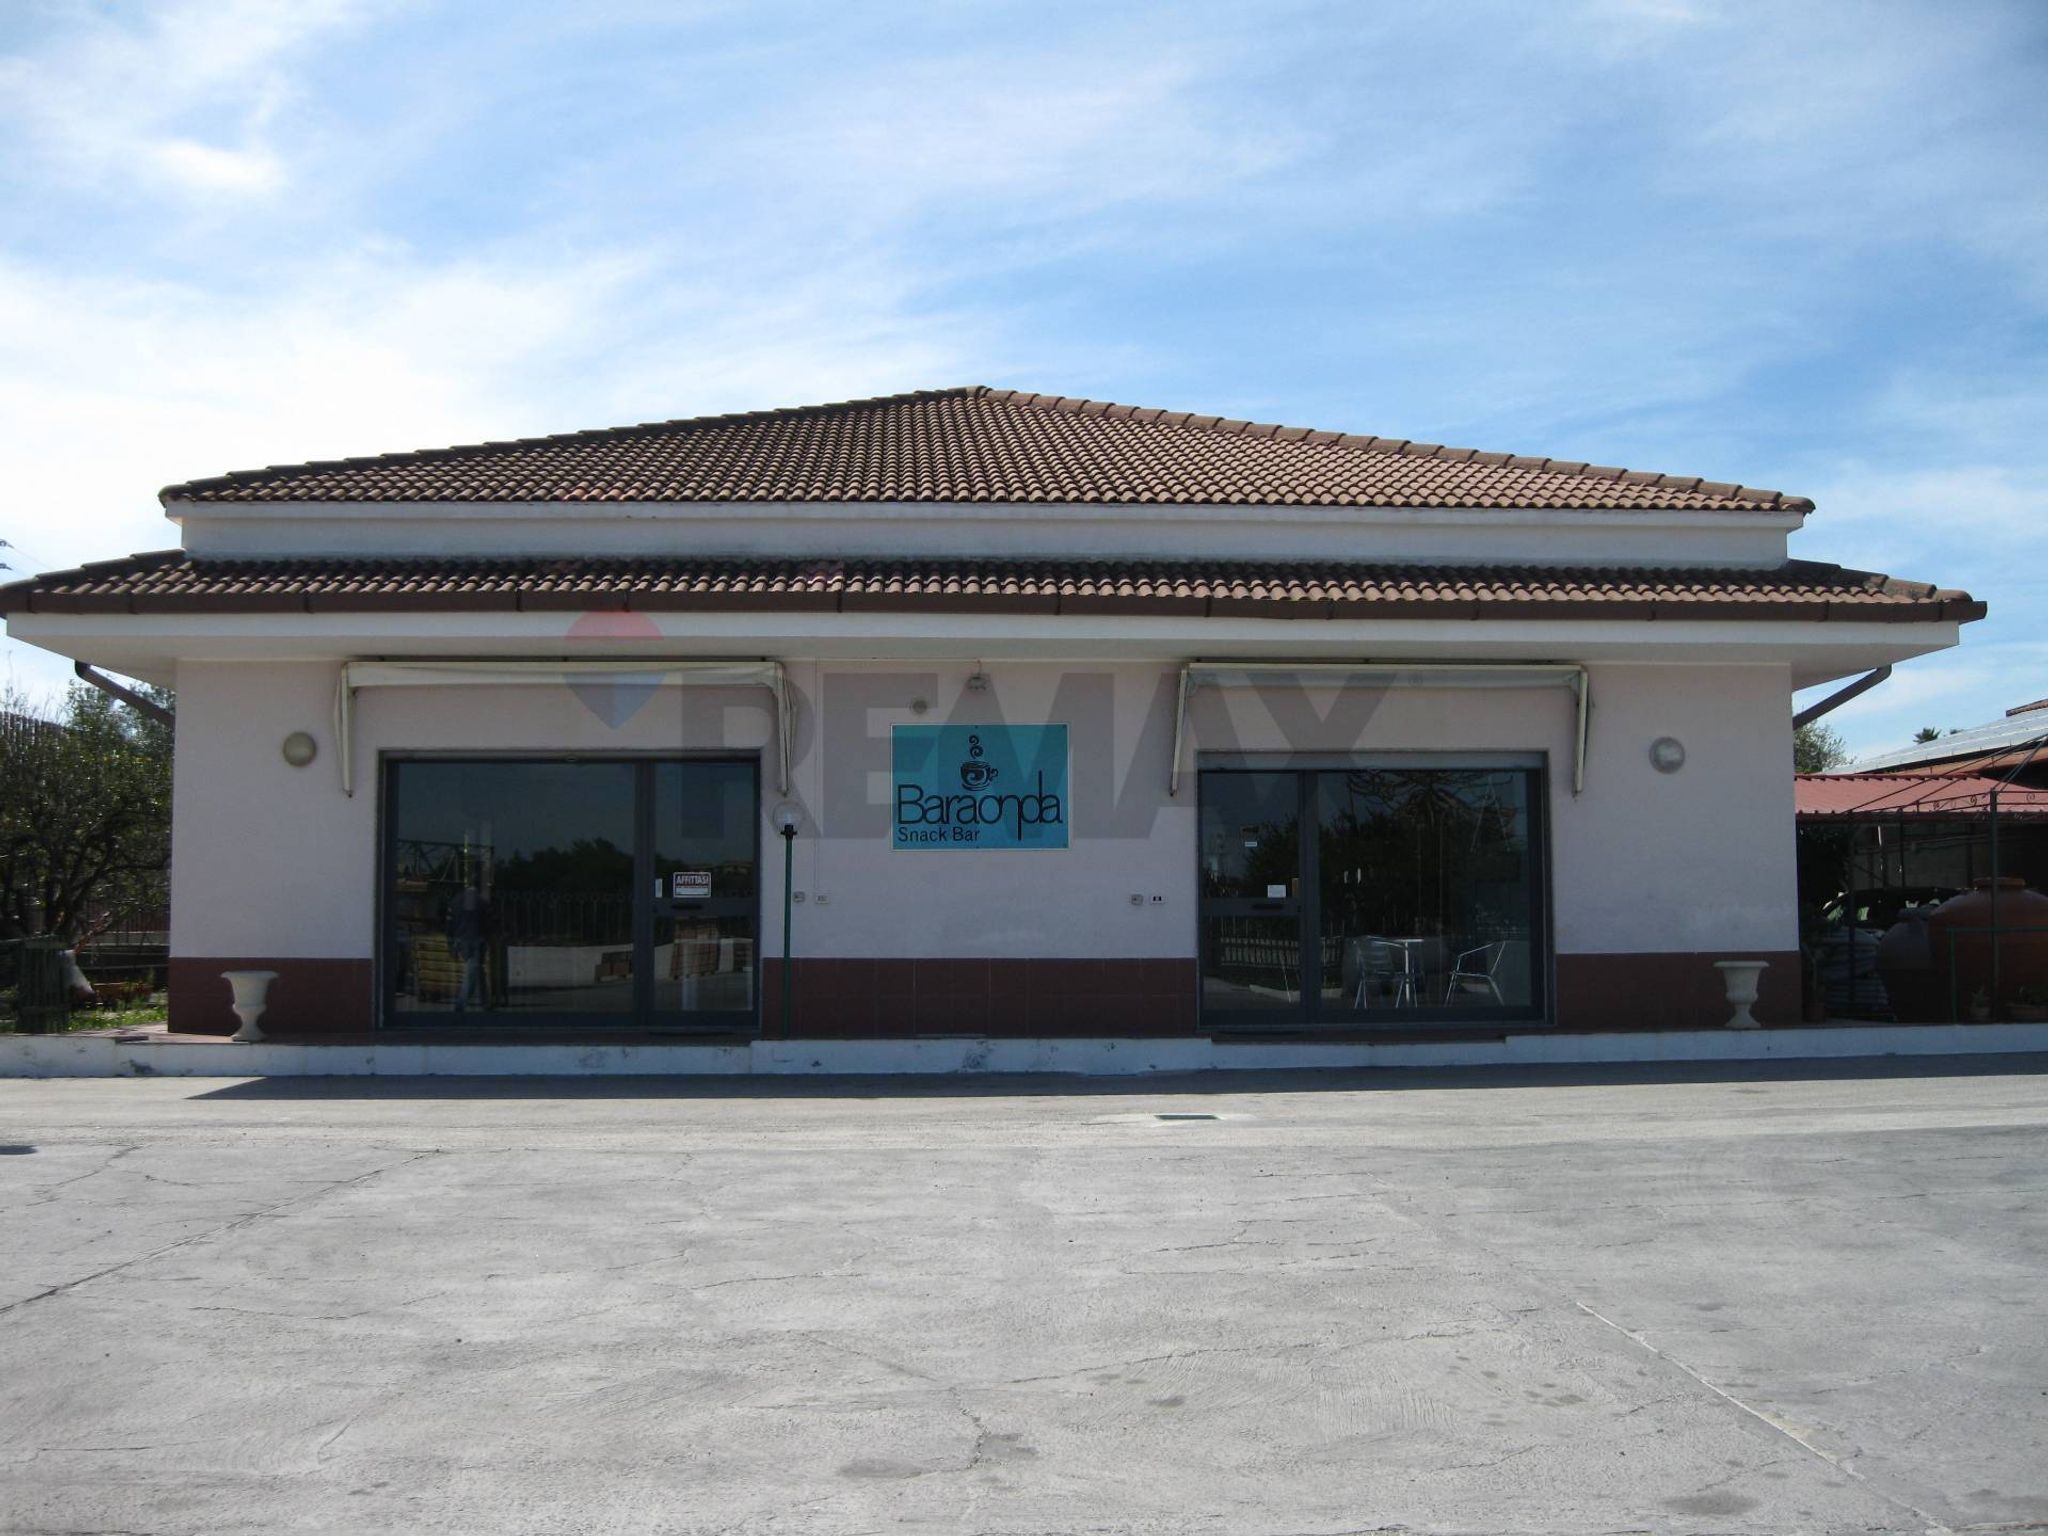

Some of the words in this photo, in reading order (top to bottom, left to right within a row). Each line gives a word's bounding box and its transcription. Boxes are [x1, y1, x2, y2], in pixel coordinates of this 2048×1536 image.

[897, 769, 1063, 841] Baraonda
[898, 826, 947, 842] Snack
[952, 826, 980, 842] Bar
